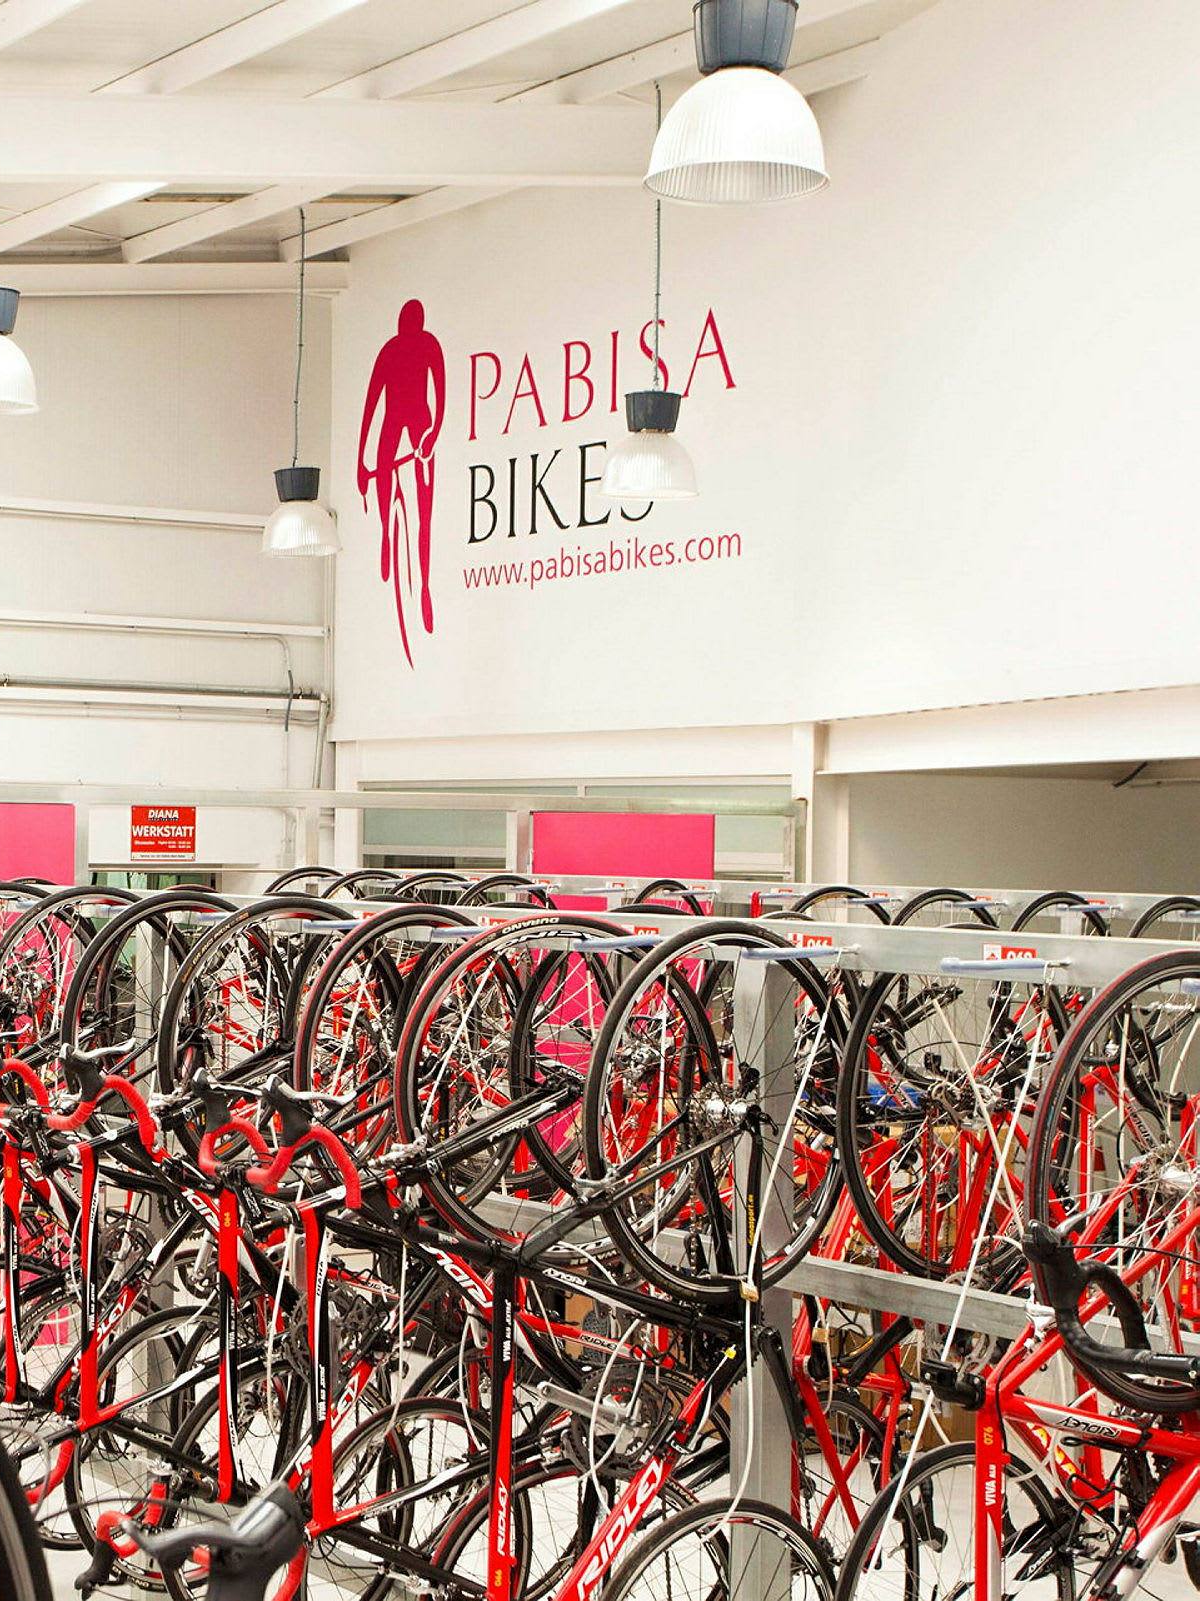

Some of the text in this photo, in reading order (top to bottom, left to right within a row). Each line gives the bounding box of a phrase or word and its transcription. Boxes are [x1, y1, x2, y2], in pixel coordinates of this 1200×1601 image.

[468, 307, 737, 441] PABISA
[463, 529, 742, 589] www.pabisabikes.com
[148, 809, 179, 819] DIANA
[132, 825, 195, 838] WERKSTATT
[502, 917, 560, 934] DURANO
[503, 1340, 511, 1362] VIVA
[580, 1334, 618, 1351] RIDLE
[983, 1426, 994, 1446] 076
[1058, 1416, 1122, 1439] RIDLEY
[985, 1463, 996, 1506] VIVA ALU
[497, 1477, 508, 1556] RIDLEY
[576, 1458, 664, 1601] RIDLEY
